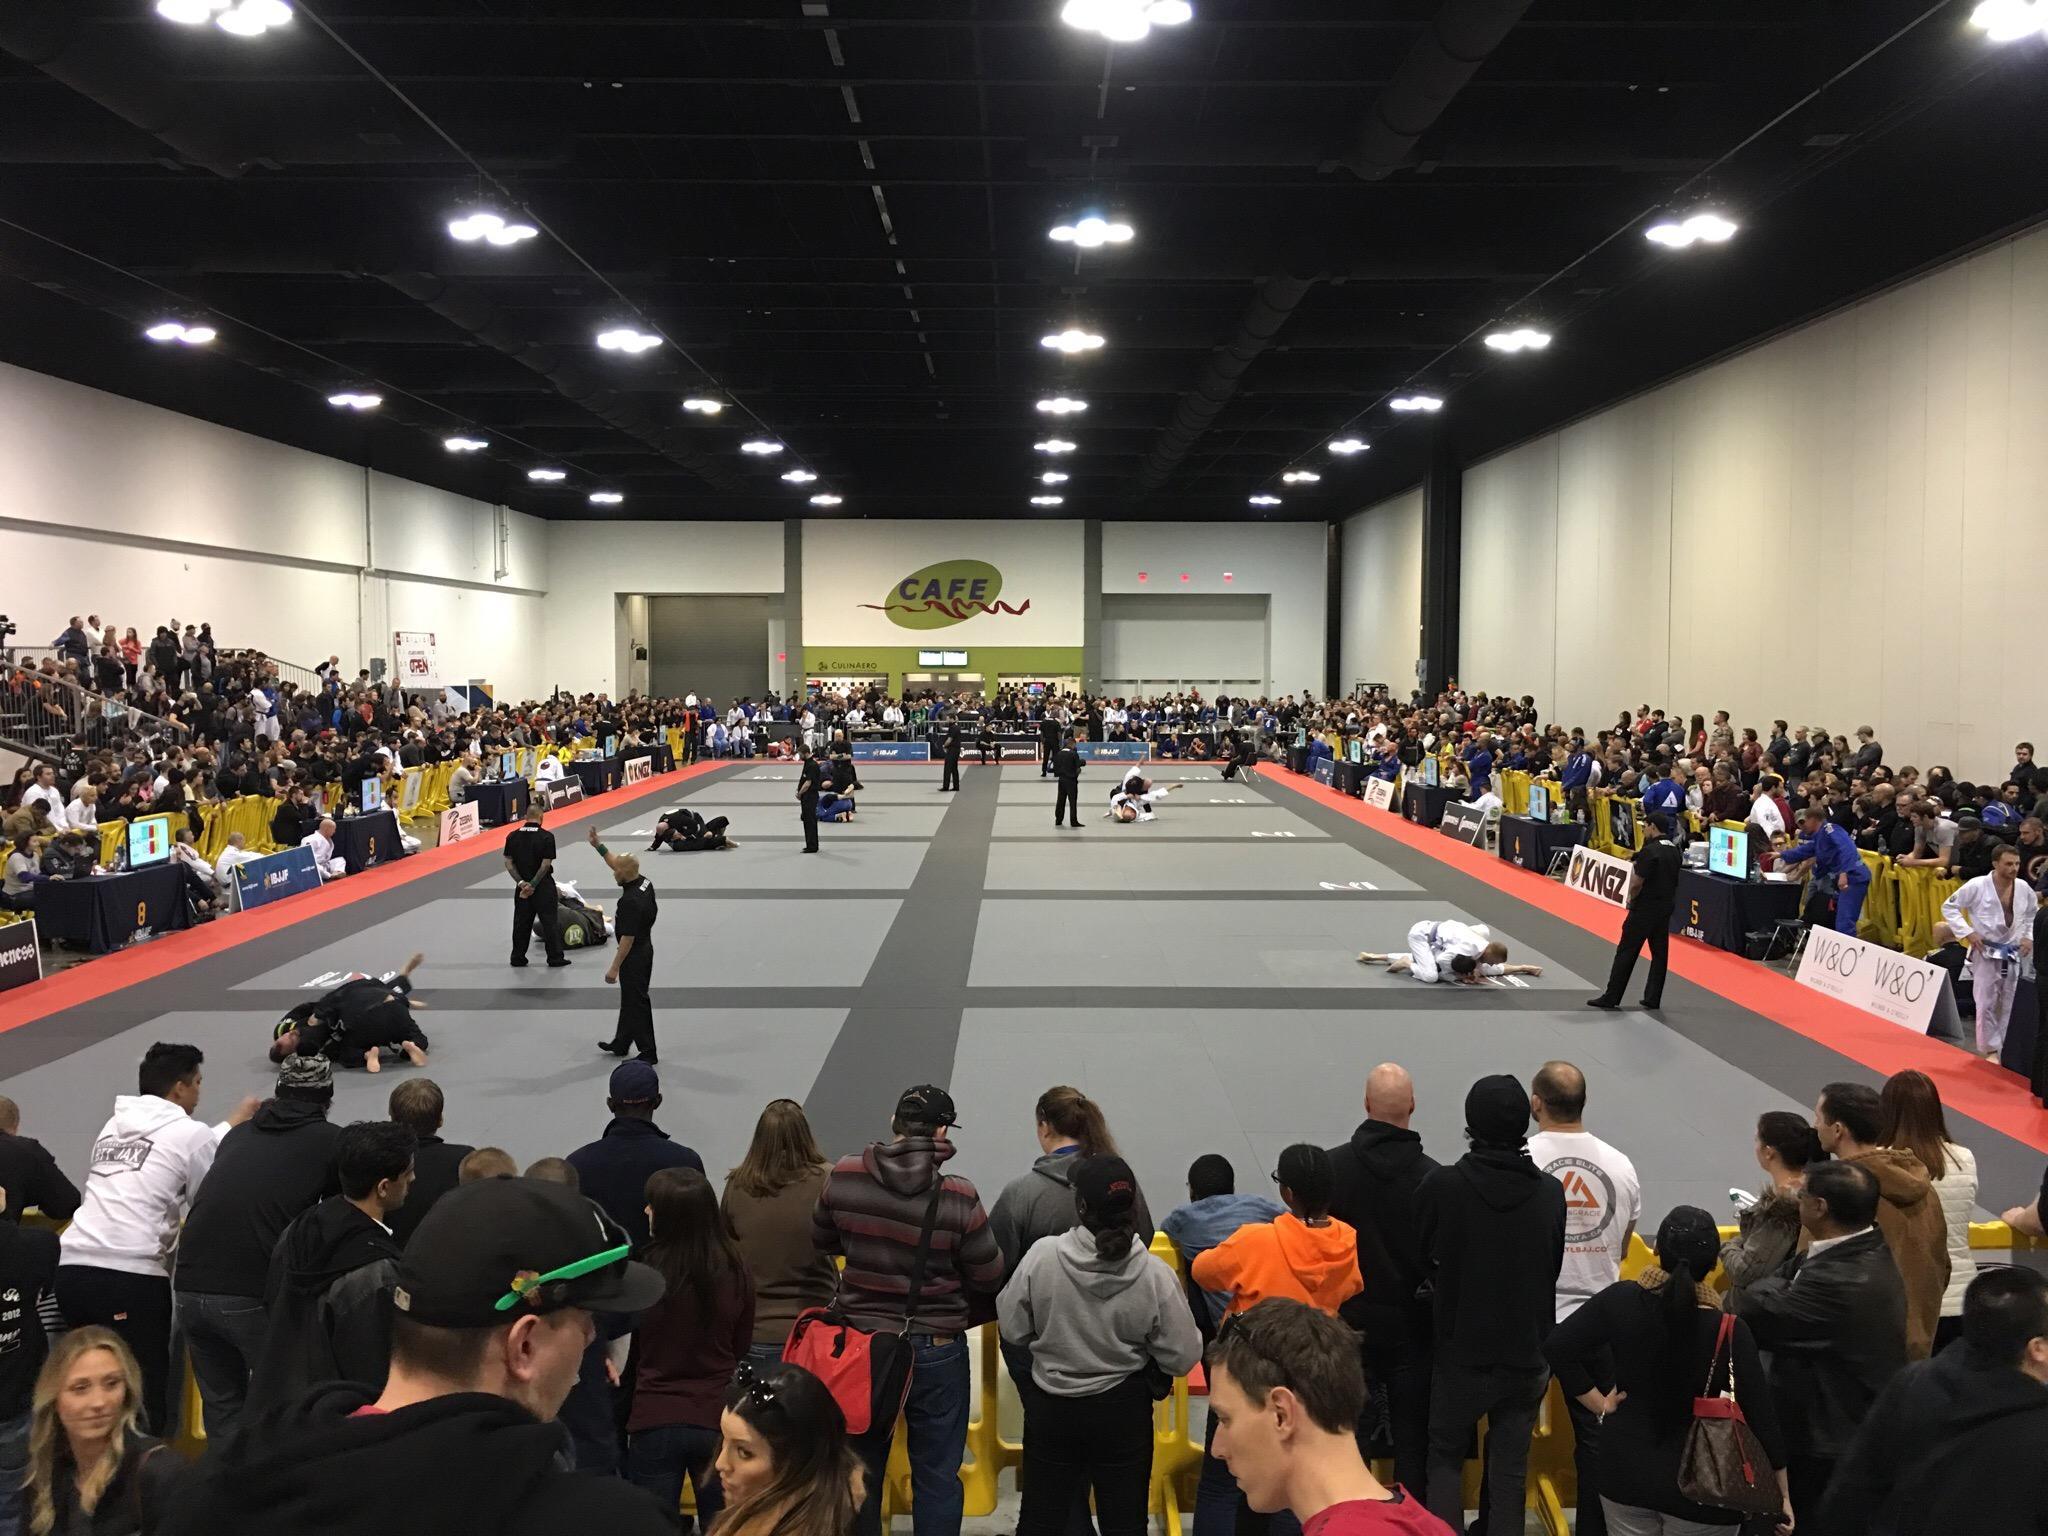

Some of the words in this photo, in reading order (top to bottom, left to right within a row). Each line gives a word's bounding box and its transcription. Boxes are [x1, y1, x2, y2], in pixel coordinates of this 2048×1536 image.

[899, 579, 988, 600] CAFE
[137, 900, 146, 926] 8
[1690, 899, 1699, 925] 5
[1575, 1159, 1604, 1177] ELITE
[2, 1307, 21, 1322] 2012
